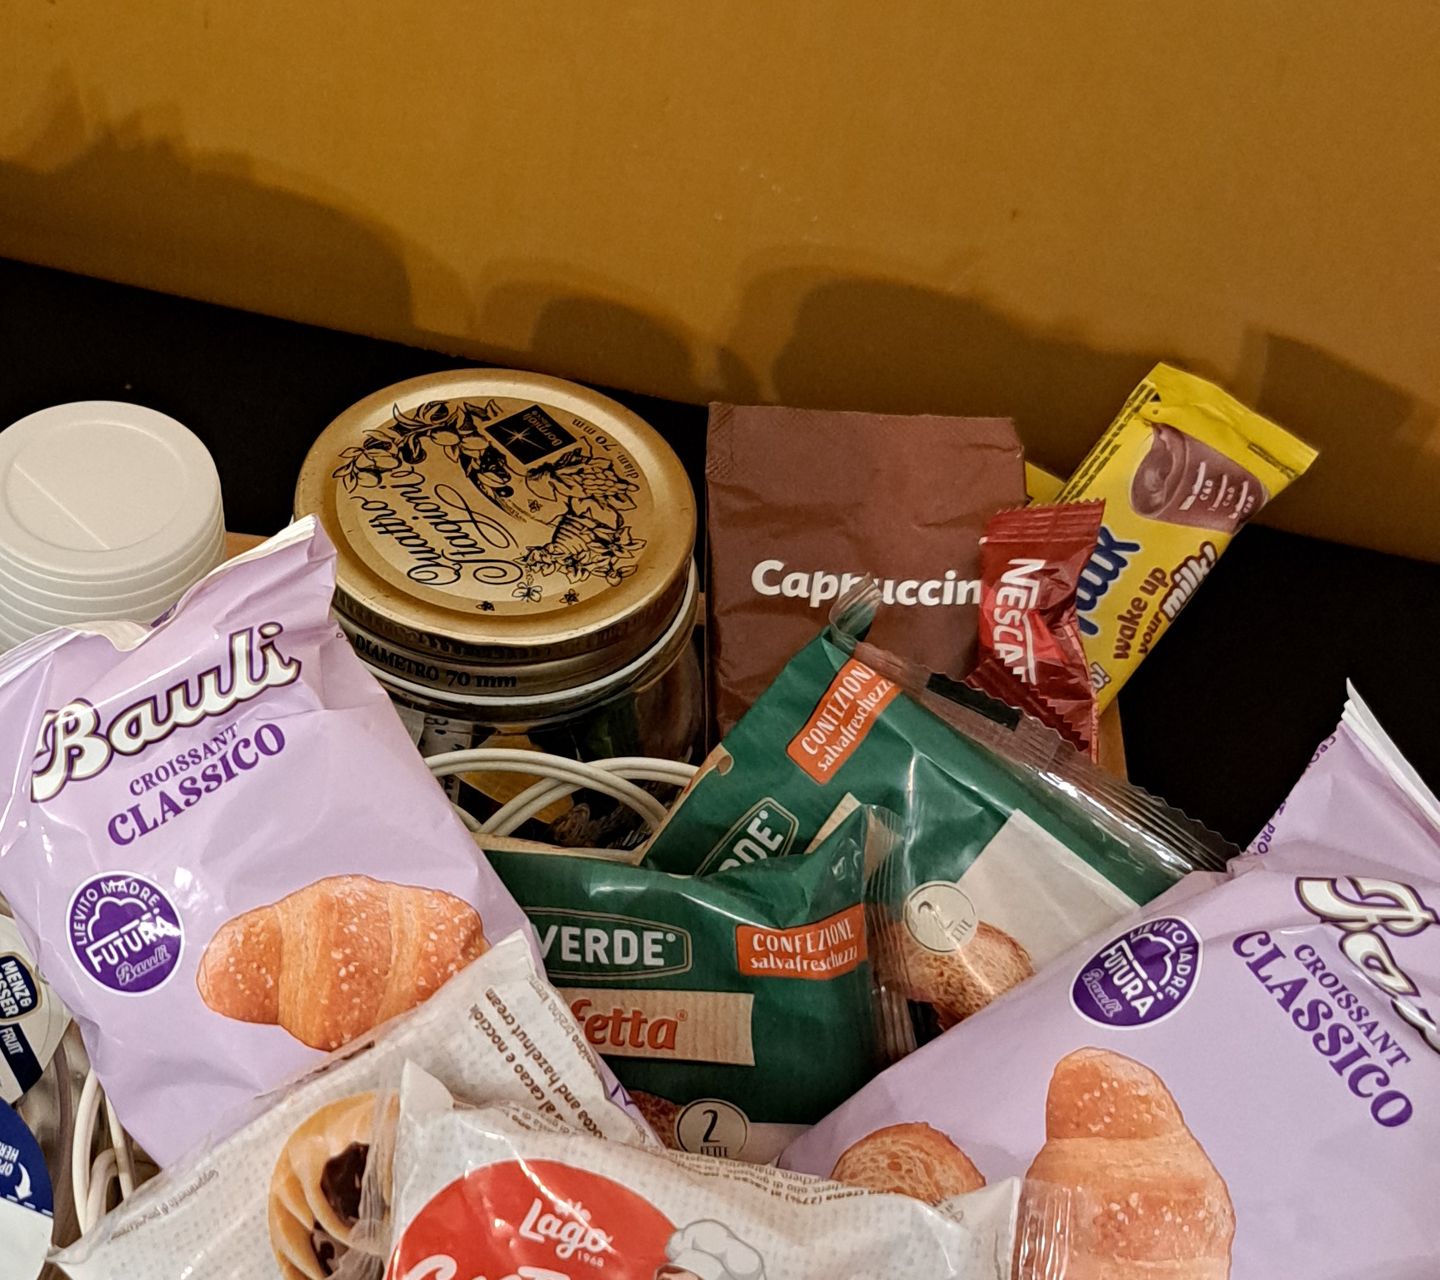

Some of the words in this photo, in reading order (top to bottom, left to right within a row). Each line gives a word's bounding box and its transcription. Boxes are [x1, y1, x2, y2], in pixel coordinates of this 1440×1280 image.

[595, 435, 618, 452] 70
[1112, 596, 1148, 661] wake
[1139, 566, 1169, 597] up
[1137, 610, 1163, 656] your
[1161, 539, 1219, 621] milk!
[355, 634, 439, 681] DIAMETRO
[445, 671, 470, 687] 70
[475, 674, 518, 688] mm
[30, 622, 303, 803] Bauli
[107, 722, 286, 846] CLASSICO
[128, 720, 239, 797] CROISSANT
[73, 887, 99, 946] LIEVITO
[100, 880, 161, 907] MADRE
[484, 987, 517, 1026] cream
[1100, 939, 1155, 1018] FUTURA
[1293, 943, 1411, 1068] CROISSANT
[505, 1051, 516, 1064] e
[511, 1024, 560, 1088] hazelnut
[1231, 929, 1414, 1128] CLASSICO
[514, 1062, 546, 1102] cacao
[553, 1082, 582, 1110] and
[700, 1109, 721, 1143] 2
[518, 1197, 615, 1260] Lago
